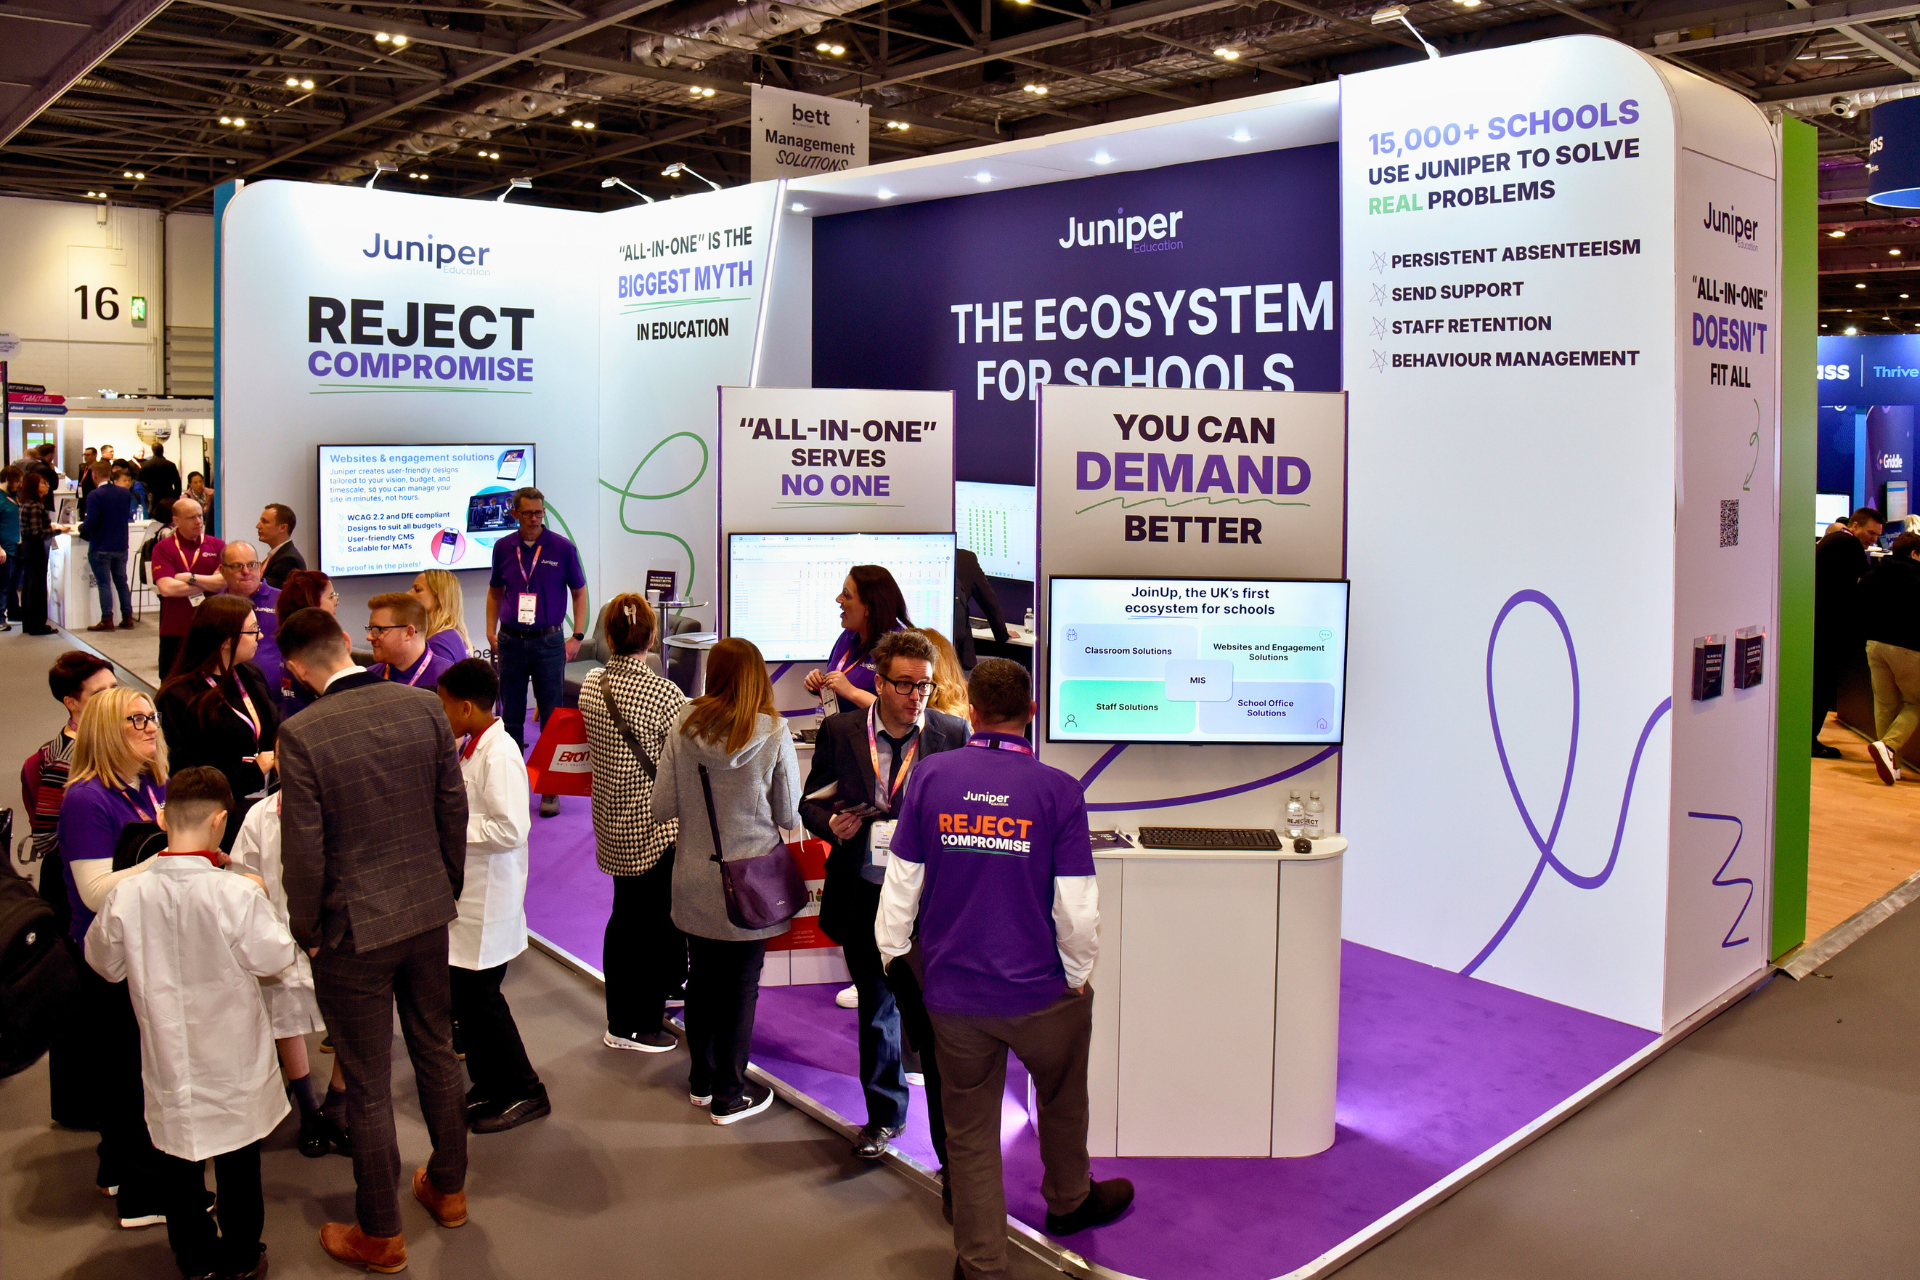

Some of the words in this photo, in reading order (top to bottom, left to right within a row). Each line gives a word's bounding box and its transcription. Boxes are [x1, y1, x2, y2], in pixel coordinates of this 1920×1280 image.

[793, 103, 830, 126] bett
[1368, 123, 1479, 158] 15,000+
[1487, 99, 1640, 140] SCHOOLS
[765, 129, 855, 155] Management
[776, 150, 848, 171] SOLUTIONS
[1369, 164, 1410, 185] USE
[1415, 152, 1511, 181] JUNIPER
[1517, 147, 1550, 169] TO
[1555, 138, 1640, 165] SOLVE
[1369, 193, 1423, 215] REAL
[1428, 179, 1556, 209] PROBLEMS
[1059, 207, 1183, 249] Juniper
[1703, 202, 1758, 243] Juniper
[708, 231, 721, 250] IS
[724, 226, 752, 247] THE
[1133, 239, 1183, 253] Education
[362, 232, 490, 269] Juniper
[1391, 248, 1497, 268] PERSISTENT
[1501, 239, 1641, 262] ABSENTEEISM
[443, 265, 491, 276] Education
[619, 268, 690, 298] BIGGEST
[694, 260, 752, 292] MYTH
[1391, 286, 1437, 302] SEND
[1440, 281, 1524, 299] SUPPORT
[74, 284, 120, 322] 16
[951, 301, 1023, 344] THE
[1035, 281, 1334, 341] ECOSYSTEM
[308, 296, 535, 351] REJECT
[637, 323, 650, 341] IN
[652, 317, 729, 340] EDUCATION
[1391, 319, 1444, 334] STAFF
[1448, 316, 1552, 333] RETENTION
[308, 350, 534, 382] COMPROMISE
[1391, 352, 1492, 368] BEHAVIOUR
[1495, 350, 1640, 367] MANAGEMENT
[977, 359, 1052, 401] FOR
[1064, 353, 1295, 391] SCHOOLS
[1710, 363, 1728, 386] FIT
[1730, 366, 1751, 388] ALL
[1873, 365, 1920, 378] Thrive
[1113, 413, 1189, 442] YOU
[1197, 415, 1275, 444] CAN
[330, 454, 377, 463] Websites
[380, 454, 386, 462] &
[389, 453, 450, 464] engagement
[452, 453, 495, 461] solutions
[791, 448, 886, 468] SERVES
[1883, 453, 1903, 469] Griddle
[387, 467, 431, 475] user-friendly
[410, 476, 436, 484] budget,
[1076, 451, 1311, 495] DEMAND
[781, 474, 824, 496] NO
[830, 474, 890, 497] ONE
[330, 495, 343, 503] site
[386, 512, 400, 520] and
[415, 511, 450, 520] compliant
[347, 525, 377, 533] Designs
[412, 522, 442, 530] budgets
[1124, 514, 1262, 545] BETTER
[347, 534, 396, 542] User-friendly
[347, 545, 379, 553] Scalable
[347, 563, 367, 572] proof
[376, 562, 383, 570] in
[399, 561, 421, 570] pixels!
[1131, 586, 1182, 600] JoinUp,
[1185, 587, 1207, 598] the
[1242, 587, 1270, 599] first
[1125, 604, 1198, 615] ecosystem
[1201, 603, 1220, 614] for
[1223, 603, 1275, 615] schools
[1084, 646, 1130, 655] Classroom
[1132, 646, 1172, 656] Solutions
[1213, 642, 1252, 651] Websites
[1254, 642, 1270, 651] and
[1272, 643, 1325, 653] Engagement
[1249, 652, 1288, 661] Solutions
[1190, 676, 1206, 684] MIS
[1096, 702, 1117, 711] Staff
[1119, 702, 1158, 711] Solutions
[1237, 699, 1267, 707] School
[1268, 699, 1294, 707] Office
[1247, 708, 1286, 717] Solutions
[963, 790, 1010, 804] Juniper
[938, 813, 1033, 839] REJECT
[941, 834, 1031, 853] COMPROMISE
